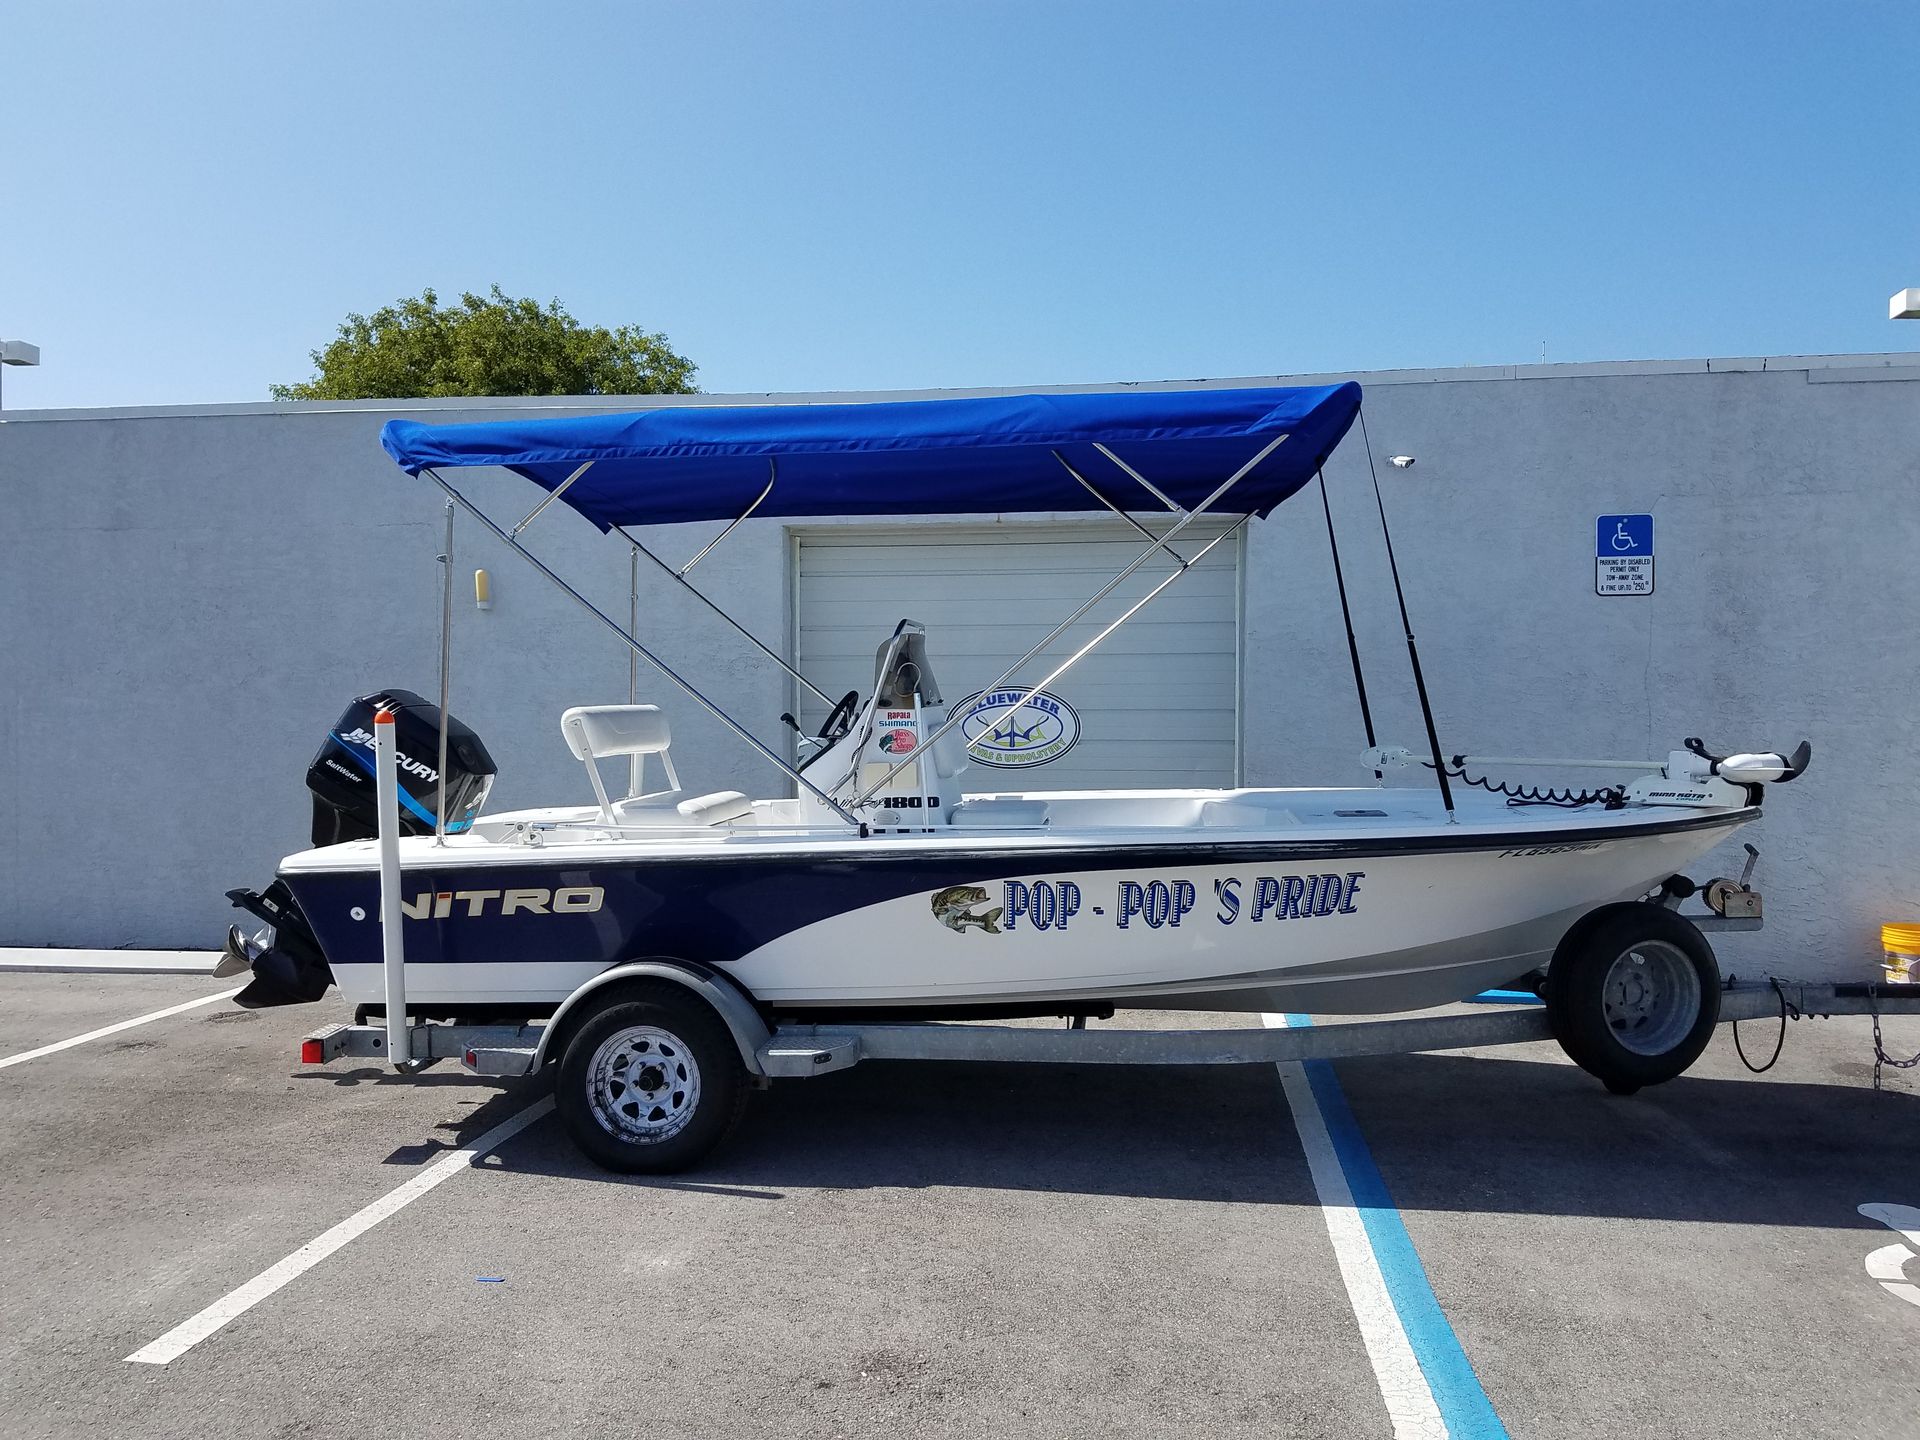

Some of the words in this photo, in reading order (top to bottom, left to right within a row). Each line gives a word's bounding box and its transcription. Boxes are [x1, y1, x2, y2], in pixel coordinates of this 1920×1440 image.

[968, 693, 1060, 714] LUEWTER
[349, 727, 440, 783] MECURY
[1004, 737, 1067, 763] UPHOLSTERY
[884, 797, 940, 809] 1800
[1002, 880, 1082, 931] POP
[1116, 880, 1197, 930] POP
[1249, 871, 1366, 923] PRIDE
